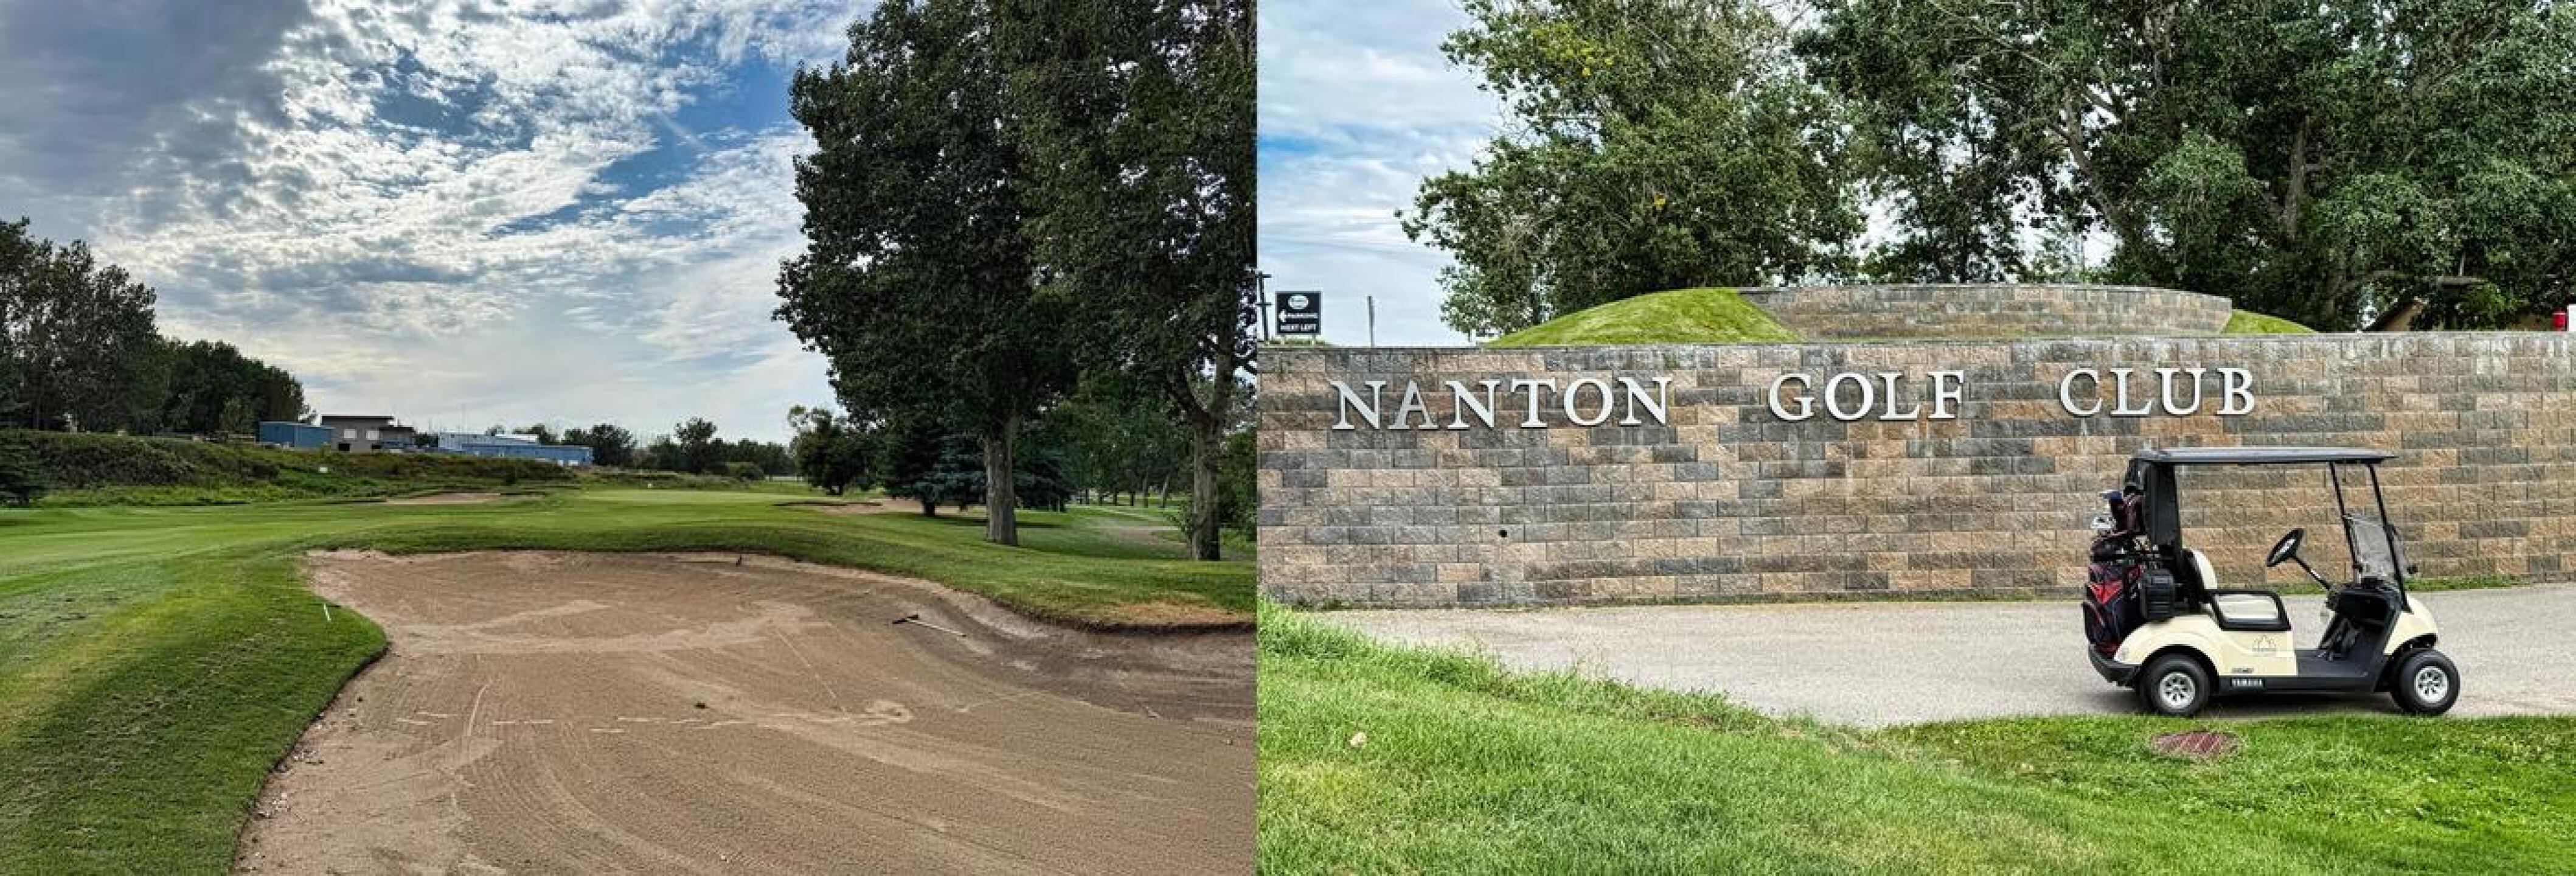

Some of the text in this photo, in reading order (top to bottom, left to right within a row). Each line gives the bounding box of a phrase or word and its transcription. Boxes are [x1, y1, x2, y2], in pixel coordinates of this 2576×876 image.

[1331, 367, 2256, 429] NANTON GOLF CLUB
